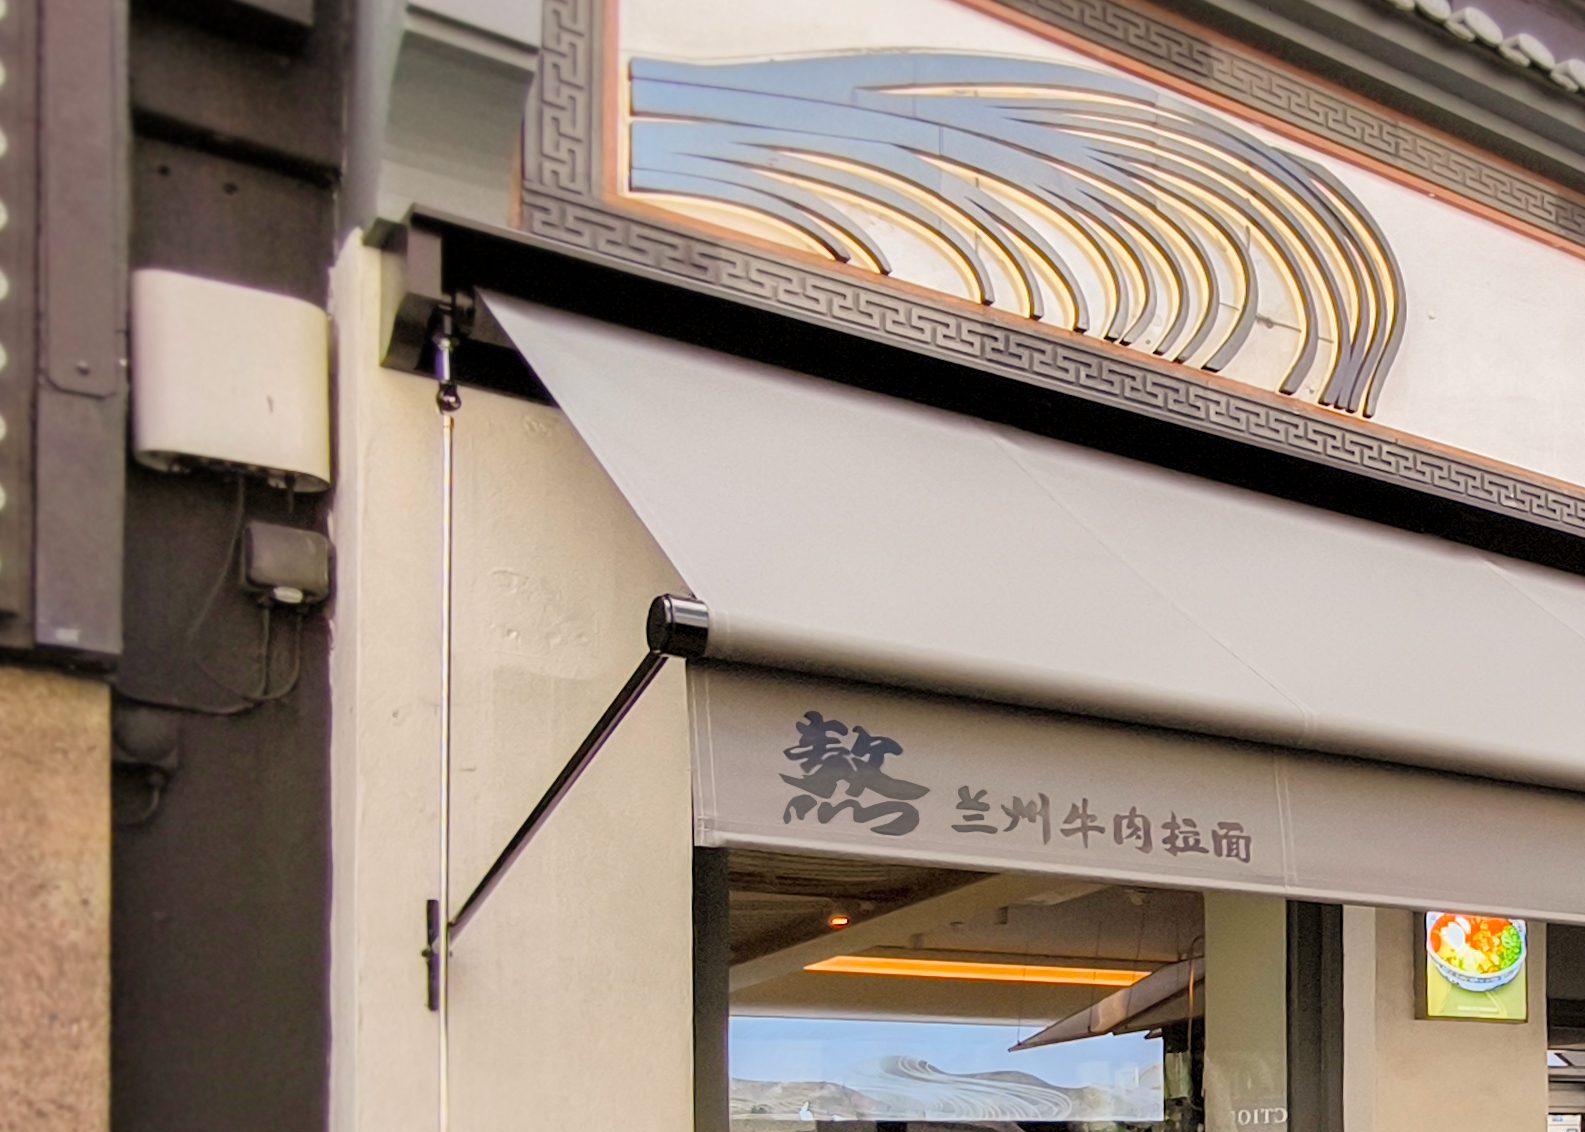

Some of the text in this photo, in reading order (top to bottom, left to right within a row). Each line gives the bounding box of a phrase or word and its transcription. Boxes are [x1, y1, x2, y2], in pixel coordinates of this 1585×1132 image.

[951, 785, 1252, 864] 兰州牛肉拉面
